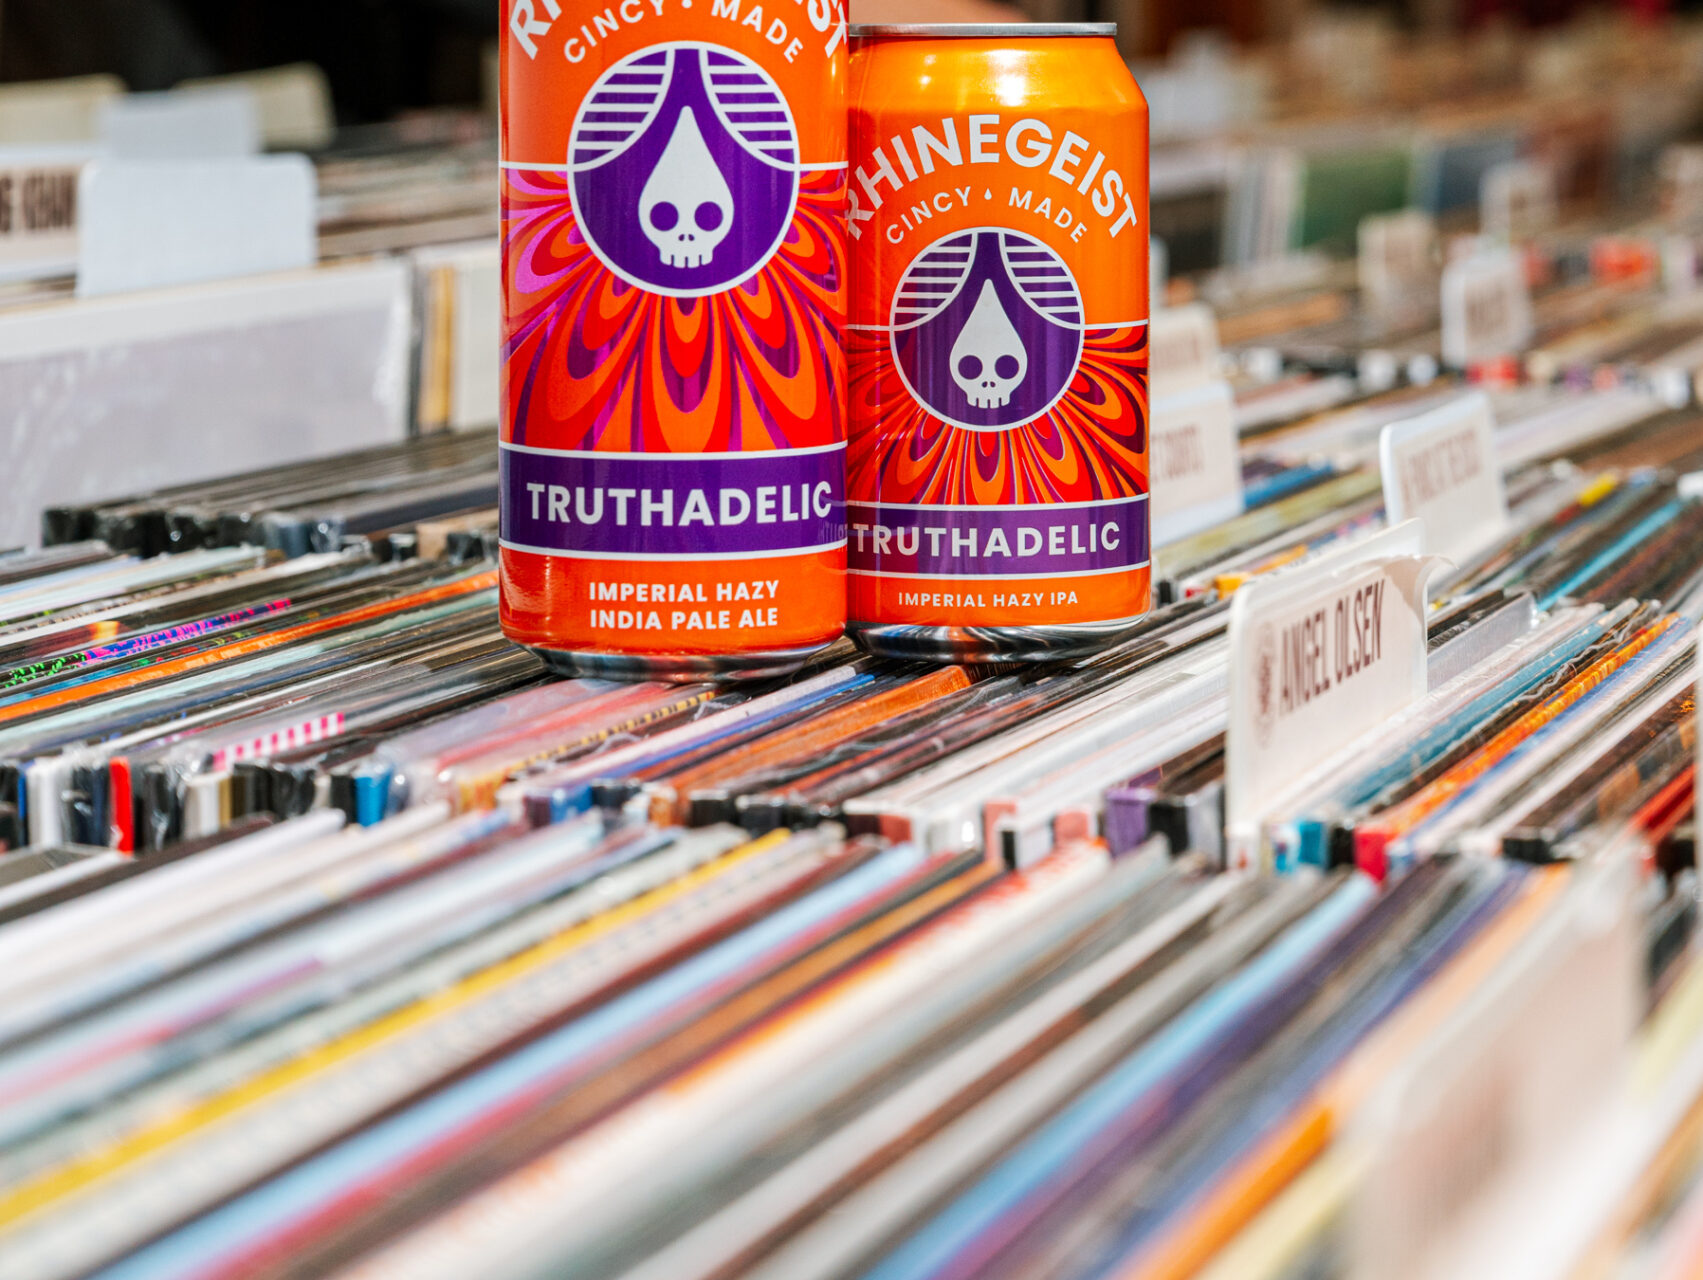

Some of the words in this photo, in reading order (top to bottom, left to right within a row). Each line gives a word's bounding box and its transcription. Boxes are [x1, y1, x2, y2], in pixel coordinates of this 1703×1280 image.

[845, 114, 1138, 240] RHINEGEIST
[886, 186, 972, 244] CINCY
[1008, 187, 1088, 244] MADE
[526, 480, 833, 527] TRUTHADELIC
[853, 521, 1121, 558] TRUTHADELIC
[589, 581, 708, 603] IMPERIAL
[716, 580, 780, 602] HAZY
[898, 592, 987, 608] IMPERIAL
[993, 592, 1044, 607] HAZY
[1050, 591, 1078, 605] IPA
[590, 609, 663, 630] INDIA
[671, 610, 730, 630] PALE
[738, 607, 778, 627] ALE
[1280, 608, 1331, 716] ANGEL
[1334, 579, 1385, 684] OLSEN
